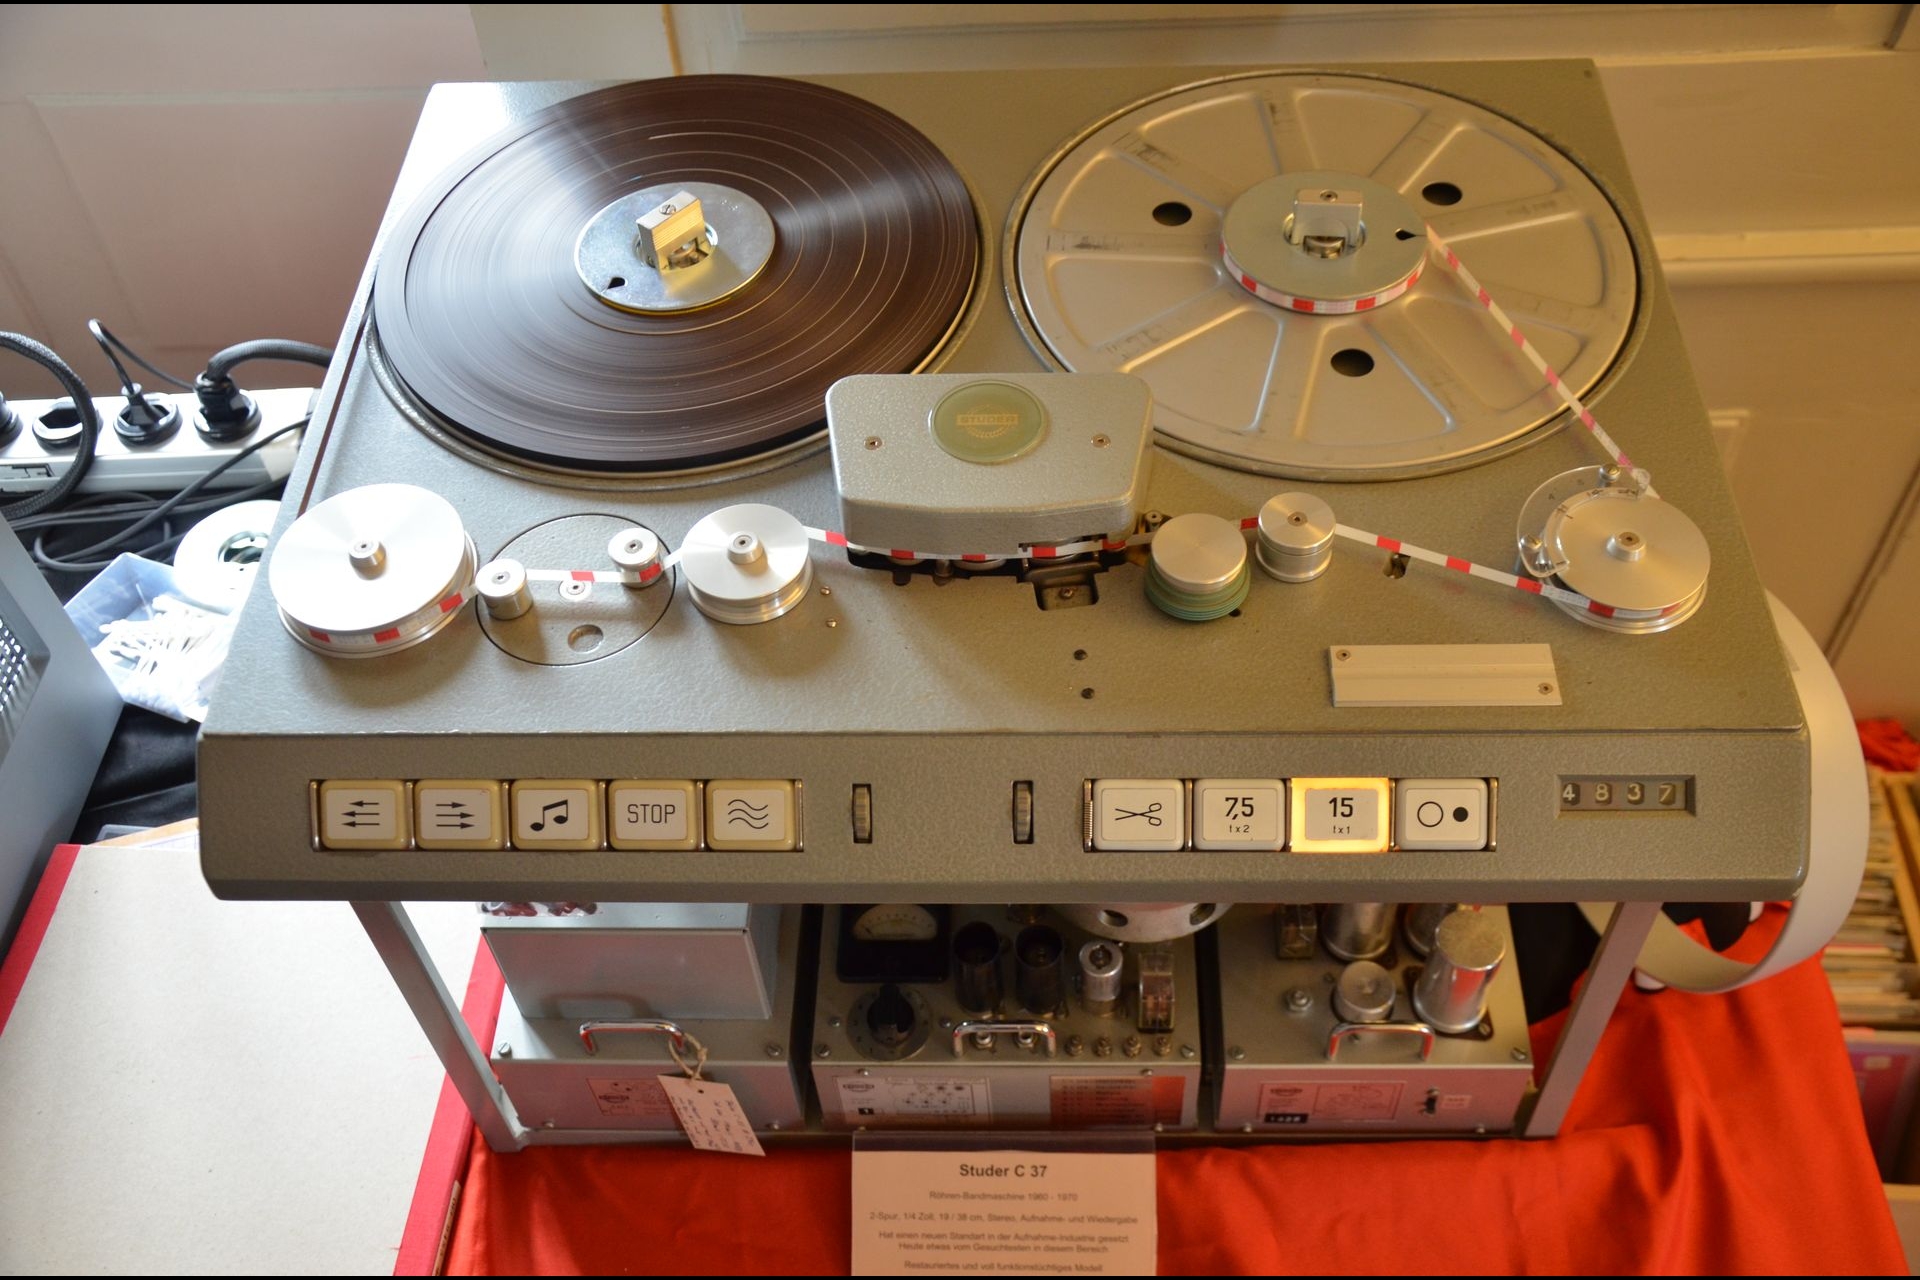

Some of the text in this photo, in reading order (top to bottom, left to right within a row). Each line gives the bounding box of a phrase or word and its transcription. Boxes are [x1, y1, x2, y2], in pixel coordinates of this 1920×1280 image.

[627, 803, 676, 824] STOP
[1225, 797, 1254, 820] 7,5
[1328, 797, 1354, 818] 15
[959, 1164, 1048, 1178] Studer C 37
[929, 1191, 1025, 1201] Röhren-Bandmaschine
[1028, 1193, 1049, 1201] 1960
[1057, 1193, 1078, 1202] 1970
[903, 1212, 916, 1220] 1/4
[939, 1213, 950, 1221] 19
[957, 1213, 968, 1221] 38
[1068, 1215, 1085, 1223] und
[1087, 1215, 1138, 1226] Wiedergabe
[879, 1230, 894, 1239] Hat
[895, 1231, 919, 1239] einen
[921, 1232, 947, 1240] neuen
[987, 1232, 995, 1240] in
[997, 1232, 1011, 1241] der
[1013, 1233, 1096, 1243] Aufnahme-Industrie
[898, 1242, 924, 1251] Heute
[926, 1243, 951, 1251] etwas
[1033, 1244, 1042, 1252] in
[1043, 1244, 1074, 1252] diesem
[904, 1260, 1103, 1273] Restauriertes und voll funktionstüchtiges Modell
